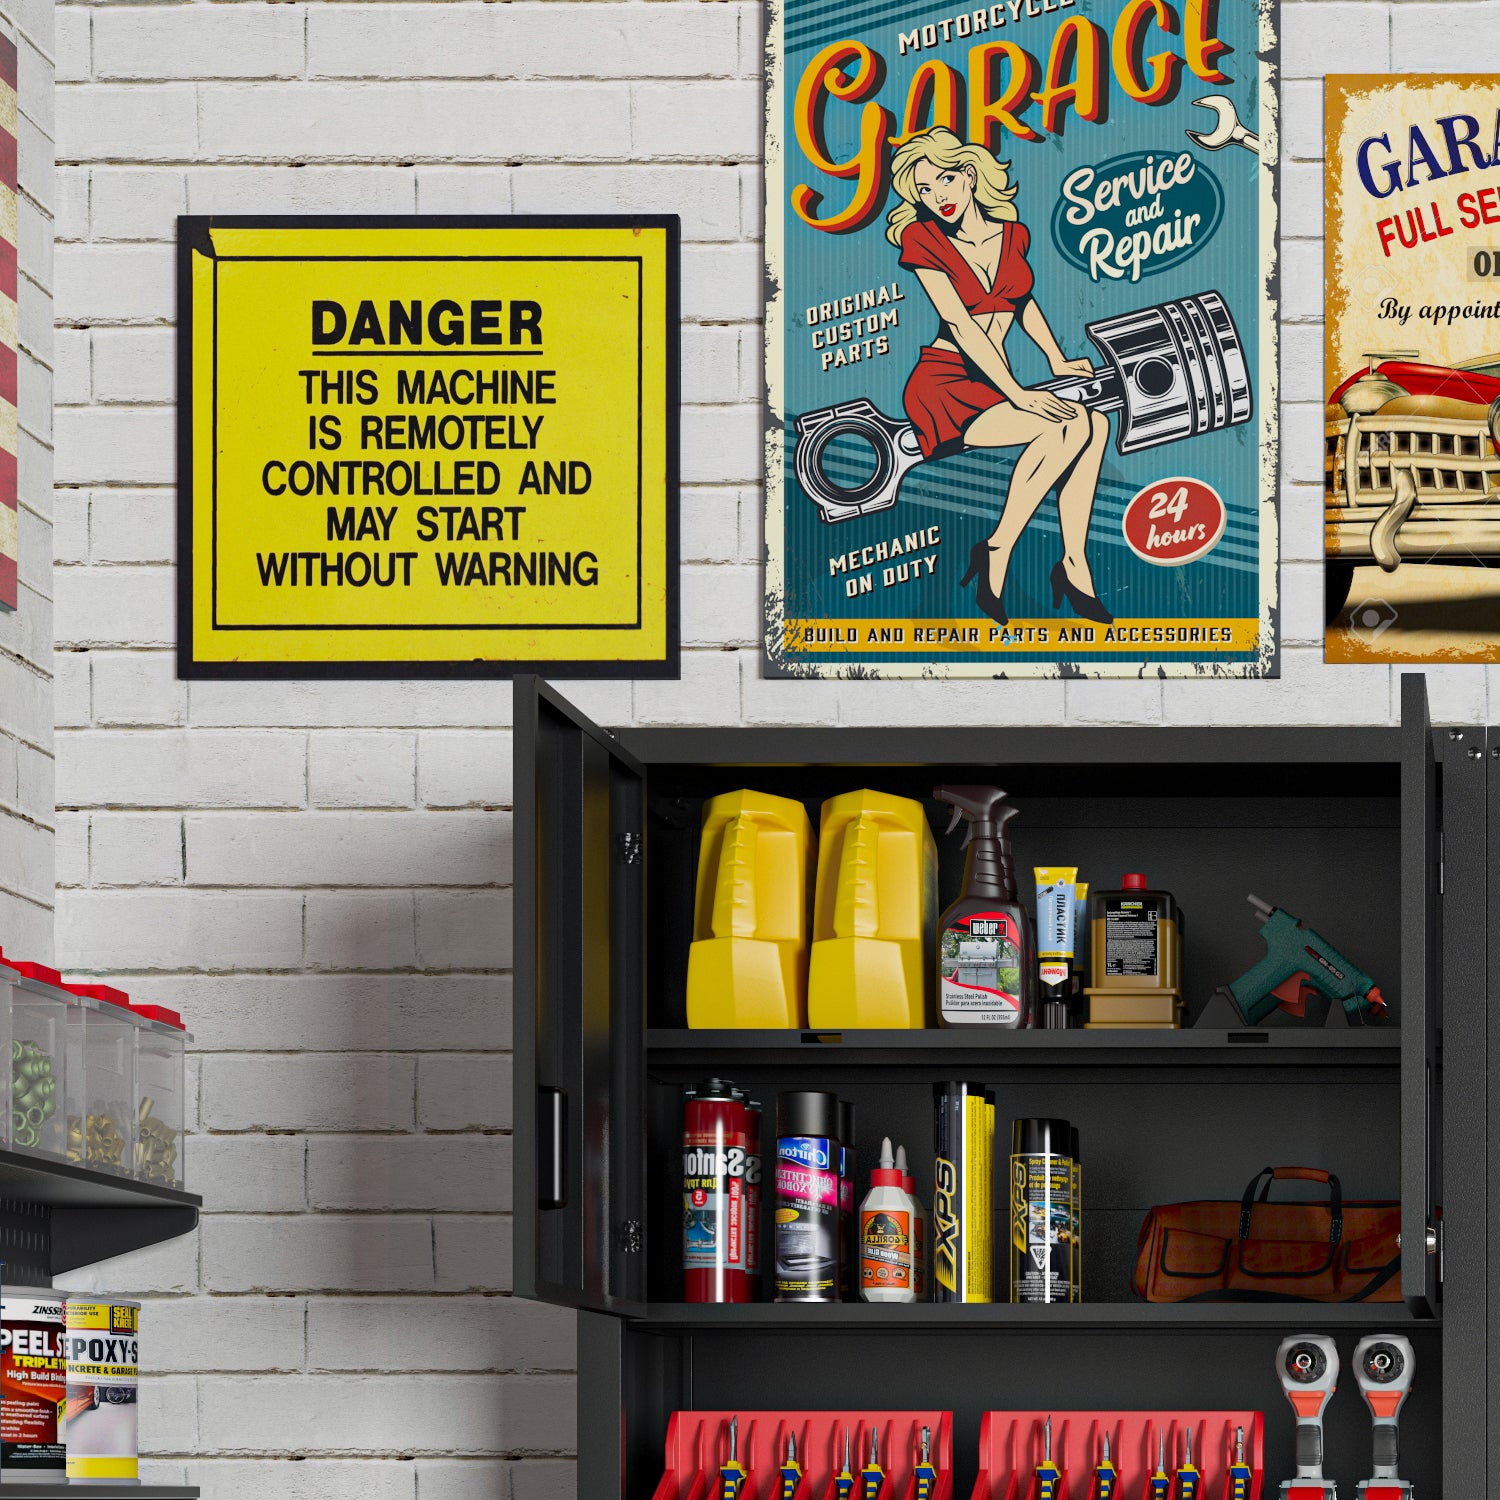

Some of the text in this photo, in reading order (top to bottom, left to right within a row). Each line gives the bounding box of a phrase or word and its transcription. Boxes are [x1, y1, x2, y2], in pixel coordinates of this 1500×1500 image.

[898, 0, 1075, 56] MOTORCYCL
[791, 0, 1235, 235] GARAGE
[1063, 151, 1196, 226] Service
[1124, 194, 1165, 227] and
[1079, 212, 1201, 284] Repair
[1375, 207, 1454, 258] FULL
[805, 282, 905, 326] ORIGINAL
[1377, 297, 1413, 325] By
[311, 300, 543, 346] DANGER
[811, 308, 900, 350] CUSTOM
[820, 335, 889, 371] PARTS
[298, 370, 557, 405] THIS MACHINE
[309, 415, 545, 450] IS REMOTELY
[261, 460, 592, 497] CONTROLLED AND
[326, 505, 526, 542] MAY START
[1149, 487, 1189, 524] 24
[829, 525, 942, 577] MECHANIC
[1146, 521, 1207, 551] hours
[256, 550, 600, 588] WITHOUT WARNING
[845, 554, 939, 599] ON DUTY
[804, 627, 1233, 644] BUILD AND REPAIR PARTS AND ACCESSORIES
[972, 921, 999, 935] weber
[1056, 893, 1067, 944] ПЛАСТИК
[6, 1369, 29, 1381] High
[12, 1355, 58, 1369] TRIPLE
